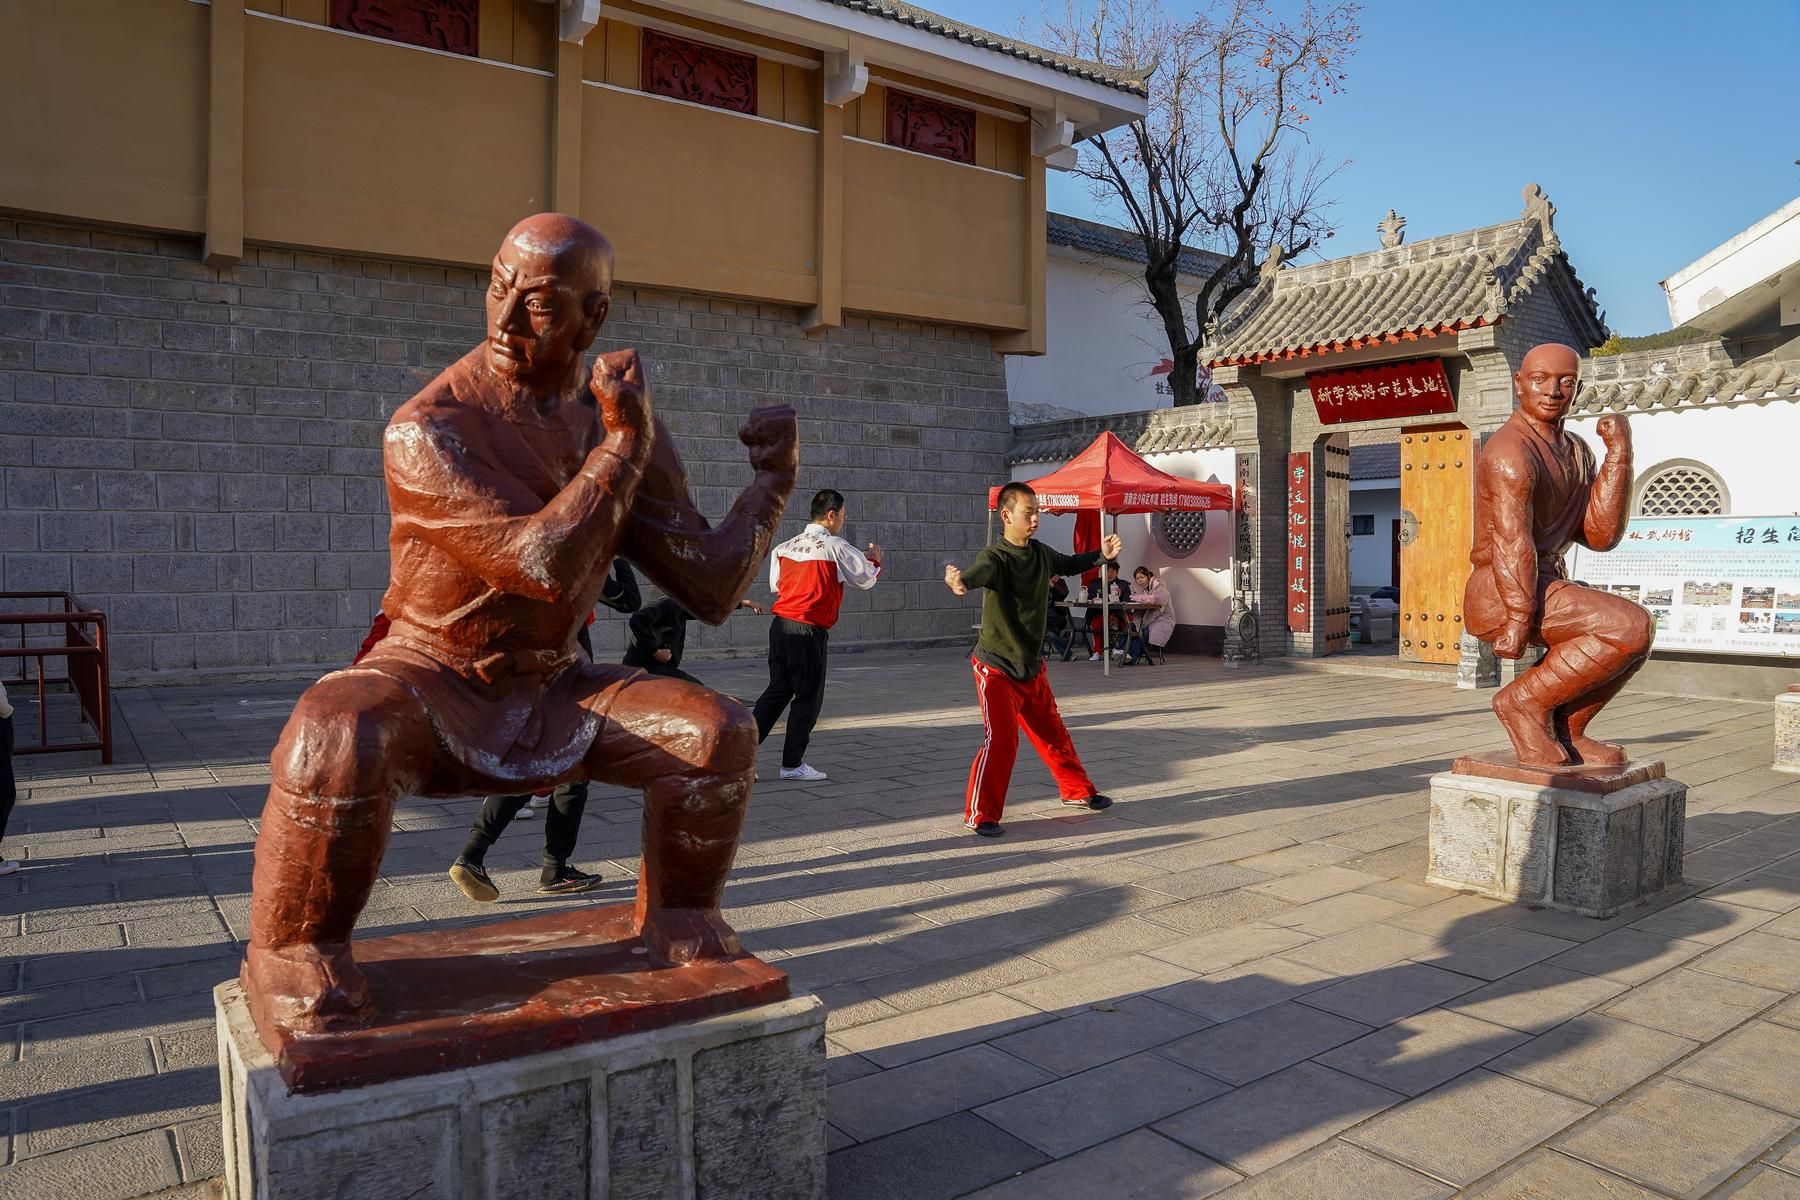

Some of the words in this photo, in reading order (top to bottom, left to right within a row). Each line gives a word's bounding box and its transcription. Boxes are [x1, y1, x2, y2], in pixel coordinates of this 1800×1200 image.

[1317, 376, 1439, 406] 研学旅游示范基地
[1291, 466, 1307, 614] 学文化悦目娱心
[1624, 528, 1693, 542] 林武術館
